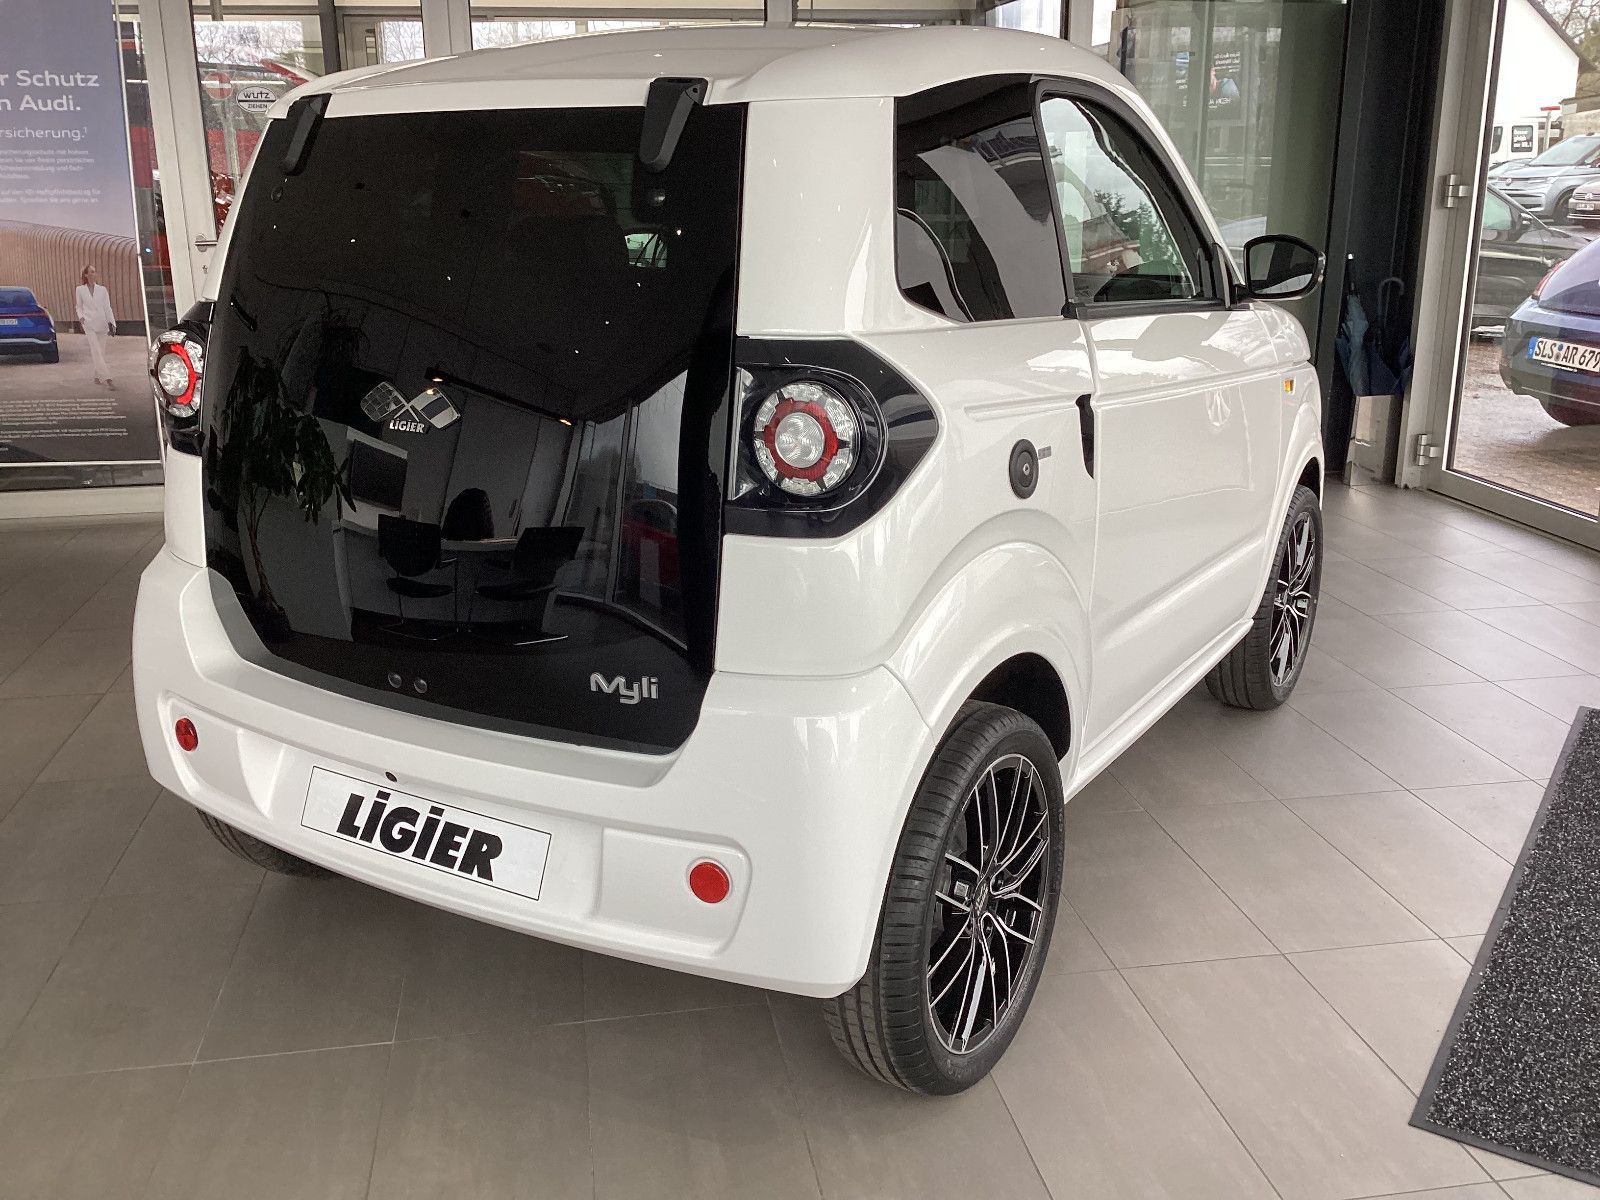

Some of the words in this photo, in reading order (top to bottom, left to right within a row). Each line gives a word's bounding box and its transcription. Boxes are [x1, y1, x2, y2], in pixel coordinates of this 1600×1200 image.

[16, 69, 100, 87] Schutz
[19, 94, 81, 111] Audi.
[1535, 340, 1556, 359] SLS
[1561, 345, 1578, 364] AR
[590, 672, 658, 705] Myli
